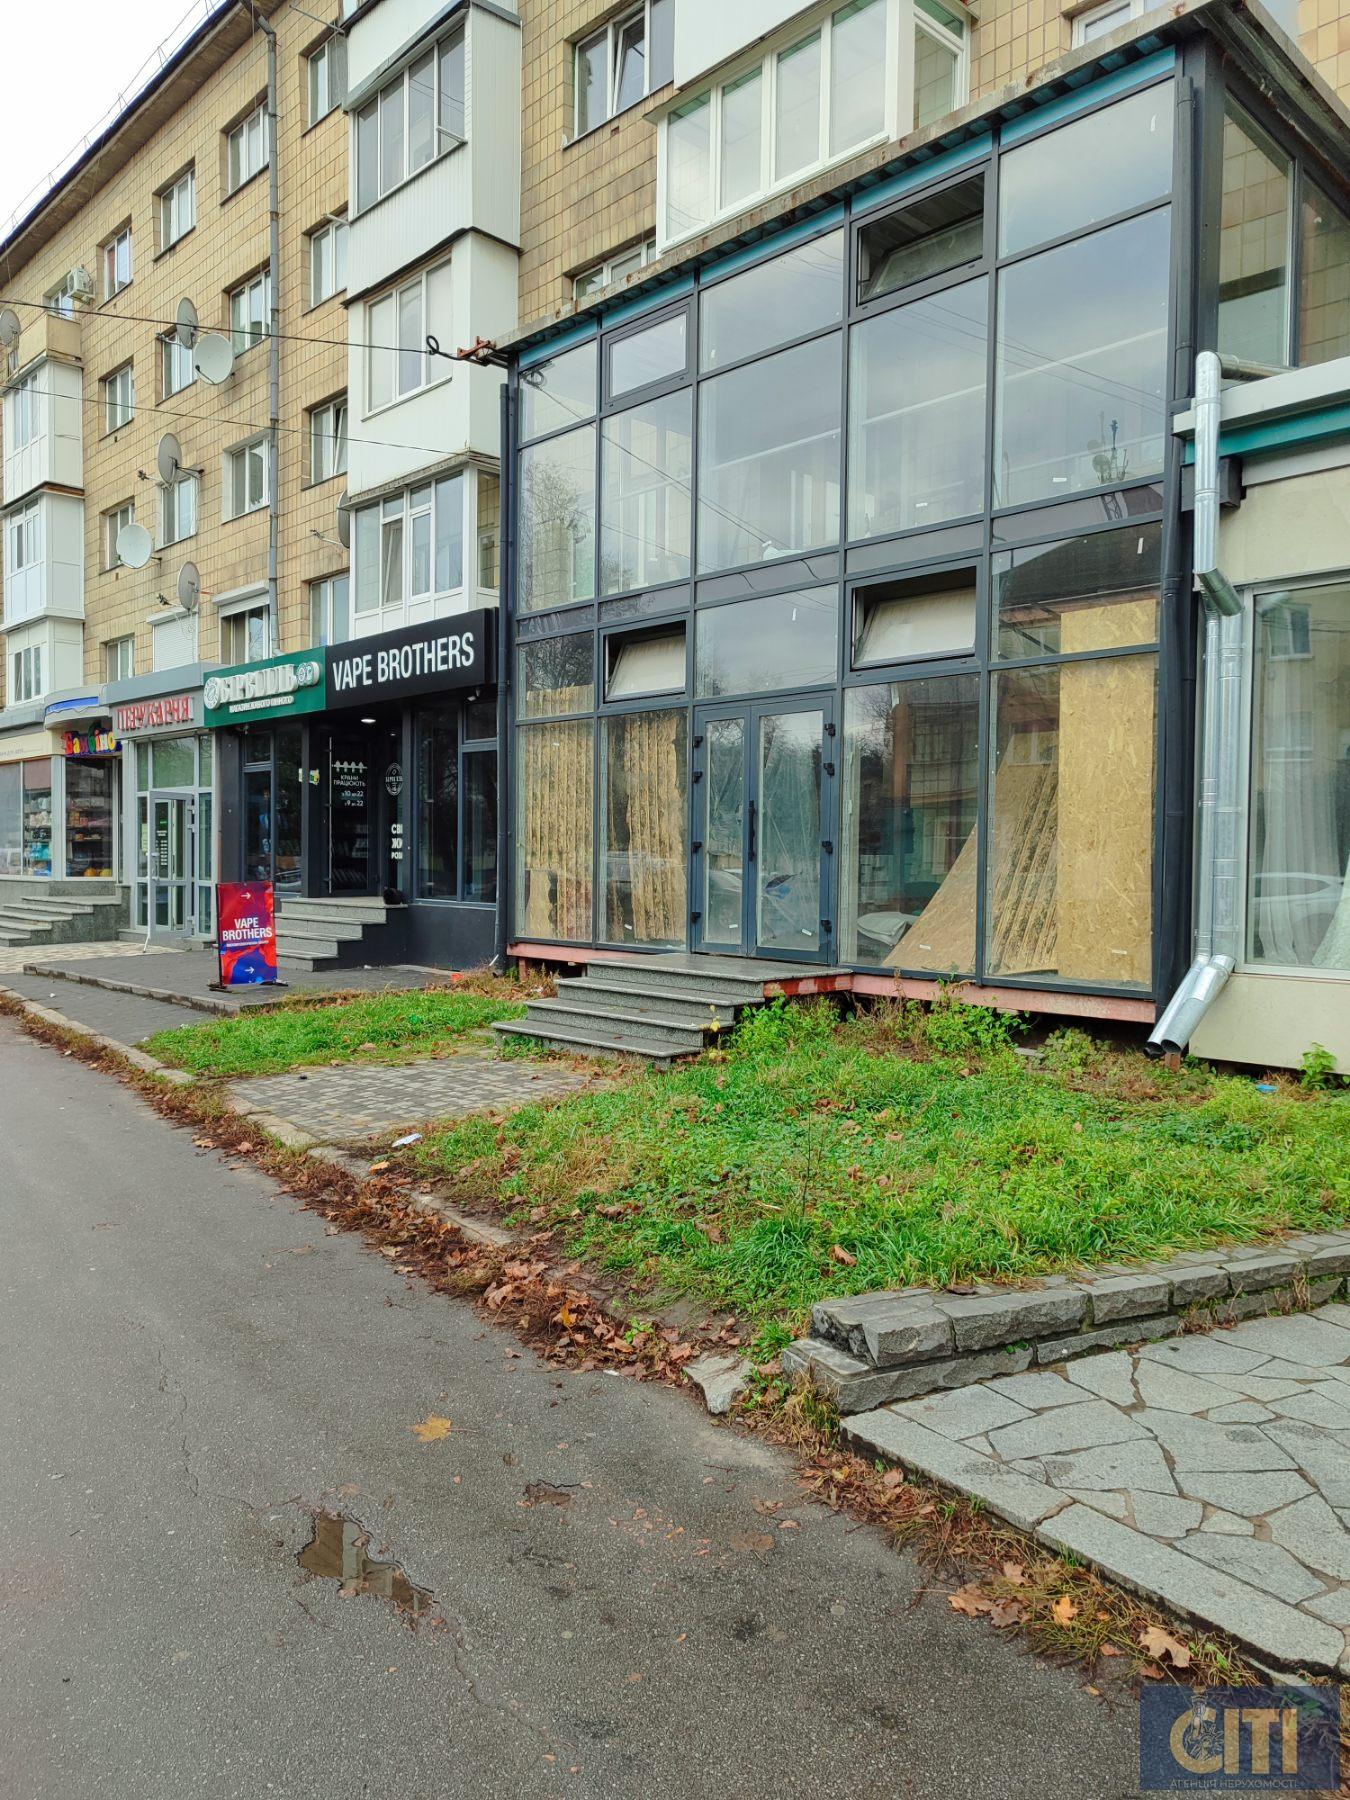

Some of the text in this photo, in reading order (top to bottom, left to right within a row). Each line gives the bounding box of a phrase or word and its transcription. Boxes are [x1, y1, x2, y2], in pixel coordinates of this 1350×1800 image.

[332, 654, 373, 691] VAPE
[377, 632, 474, 683] BROTHERS
[117, 695, 192, 731] ПЕРУКАРНЯ
[222, 927, 273, 941] BROTHERS
[234, 917, 259, 929] VAPE
